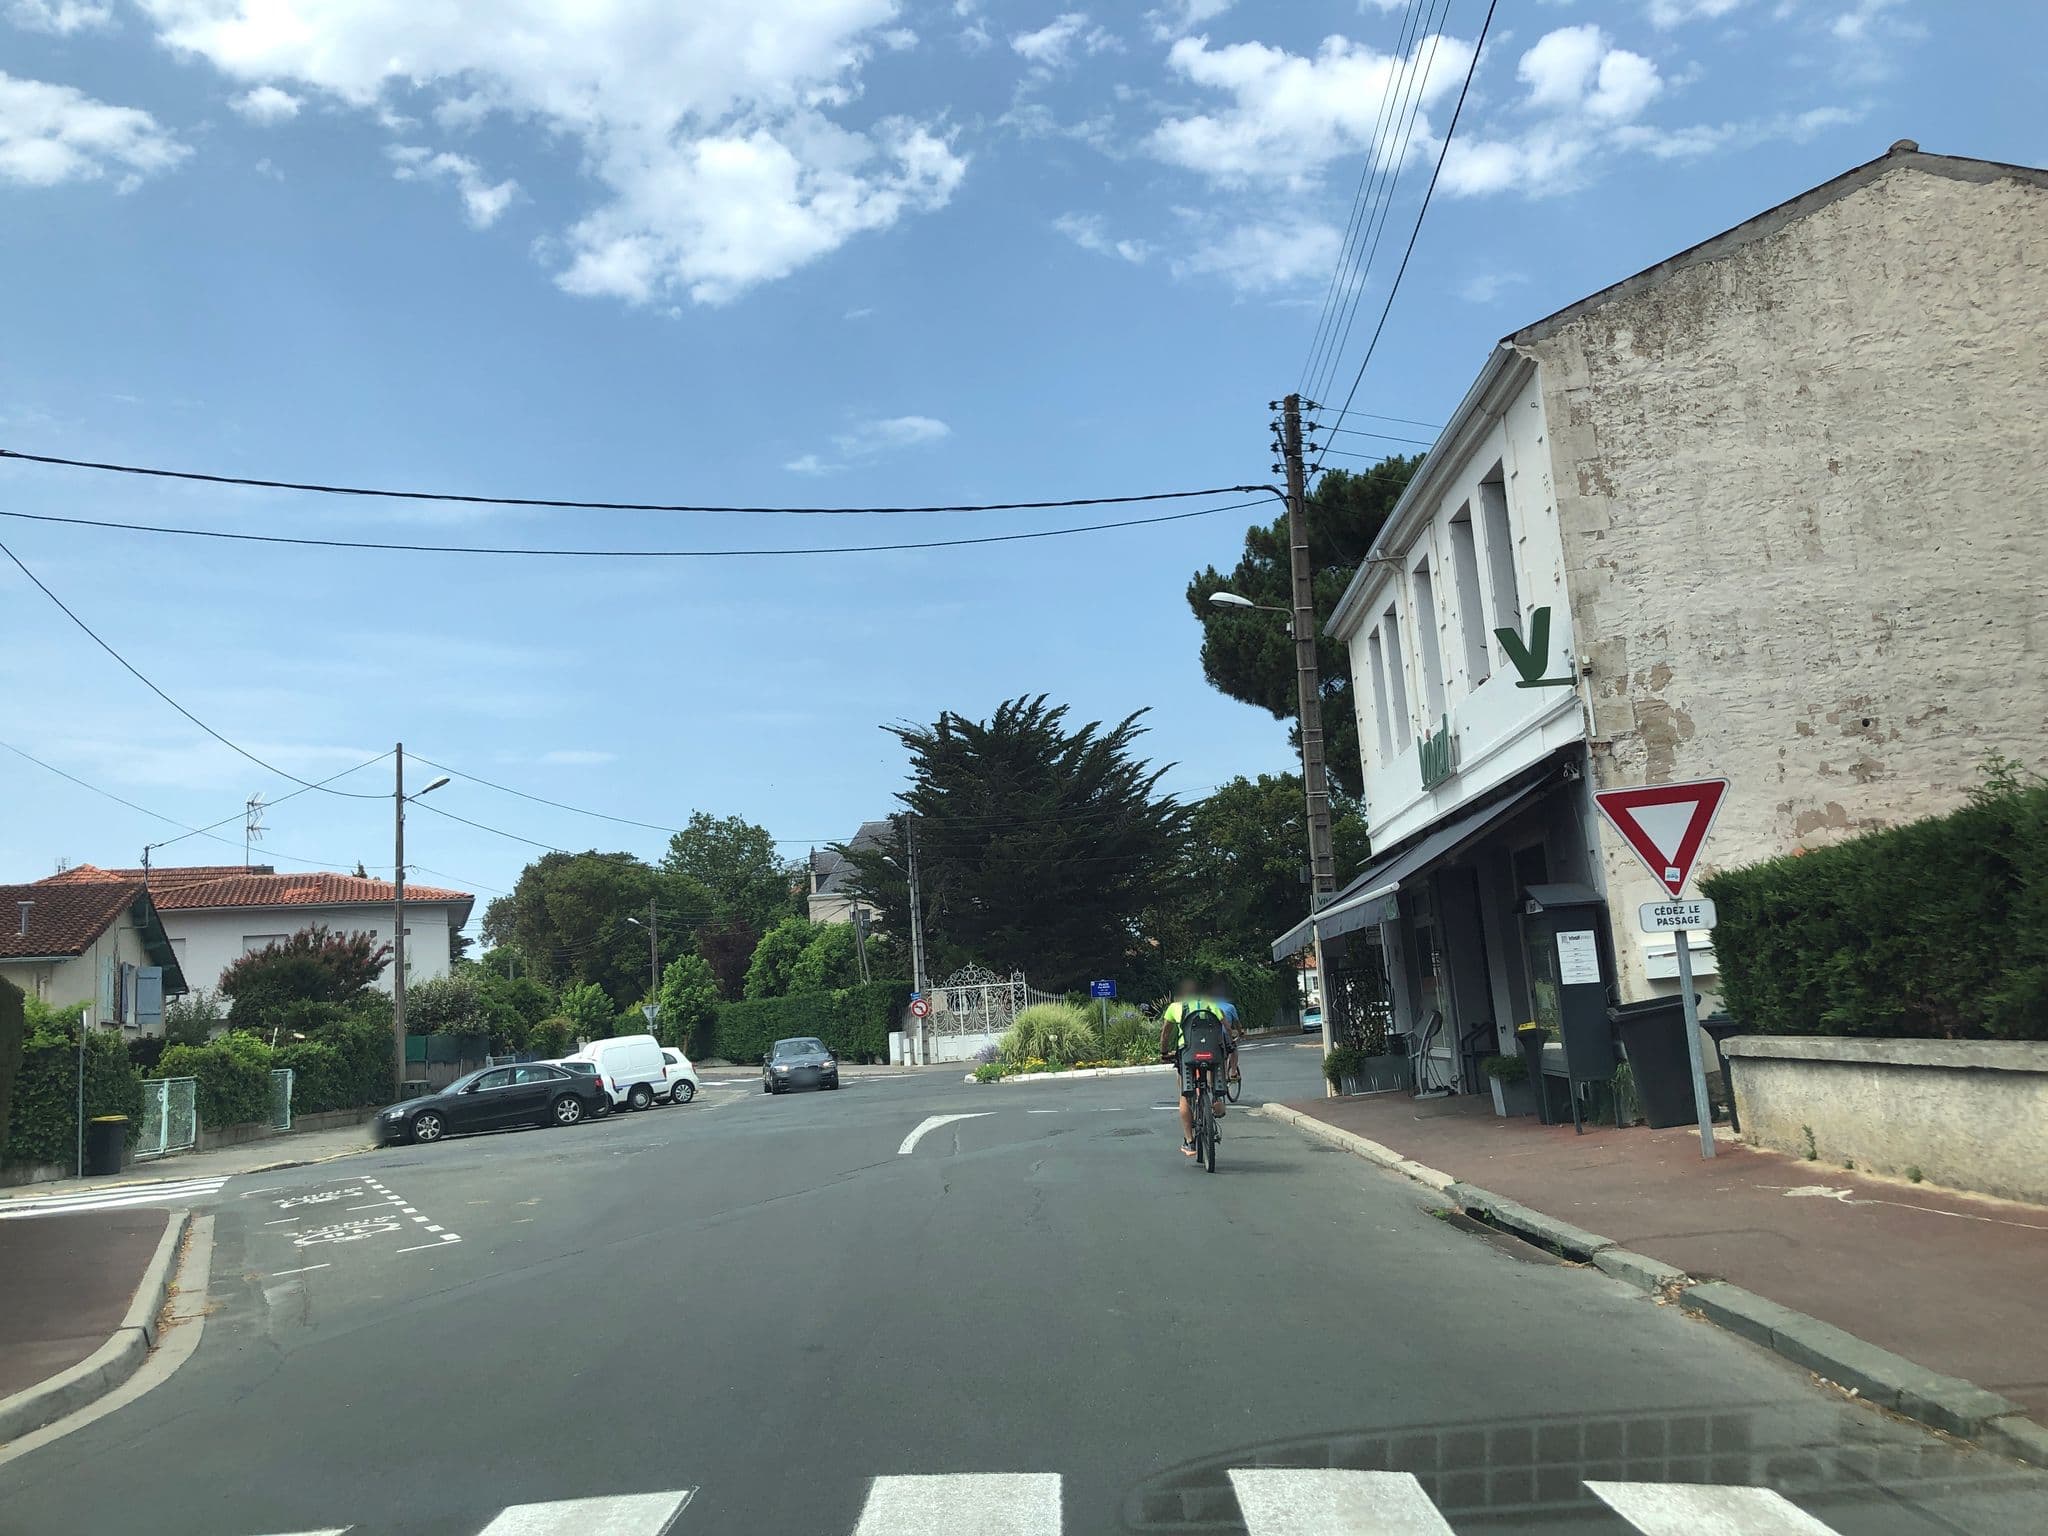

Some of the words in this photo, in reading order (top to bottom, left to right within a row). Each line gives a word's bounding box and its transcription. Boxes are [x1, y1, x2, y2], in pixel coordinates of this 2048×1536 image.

[1654, 905, 1685, 916] CÉDEZ
[1689, 905, 1700, 914] LE
[1657, 915, 1700, 926] PASSAGE
